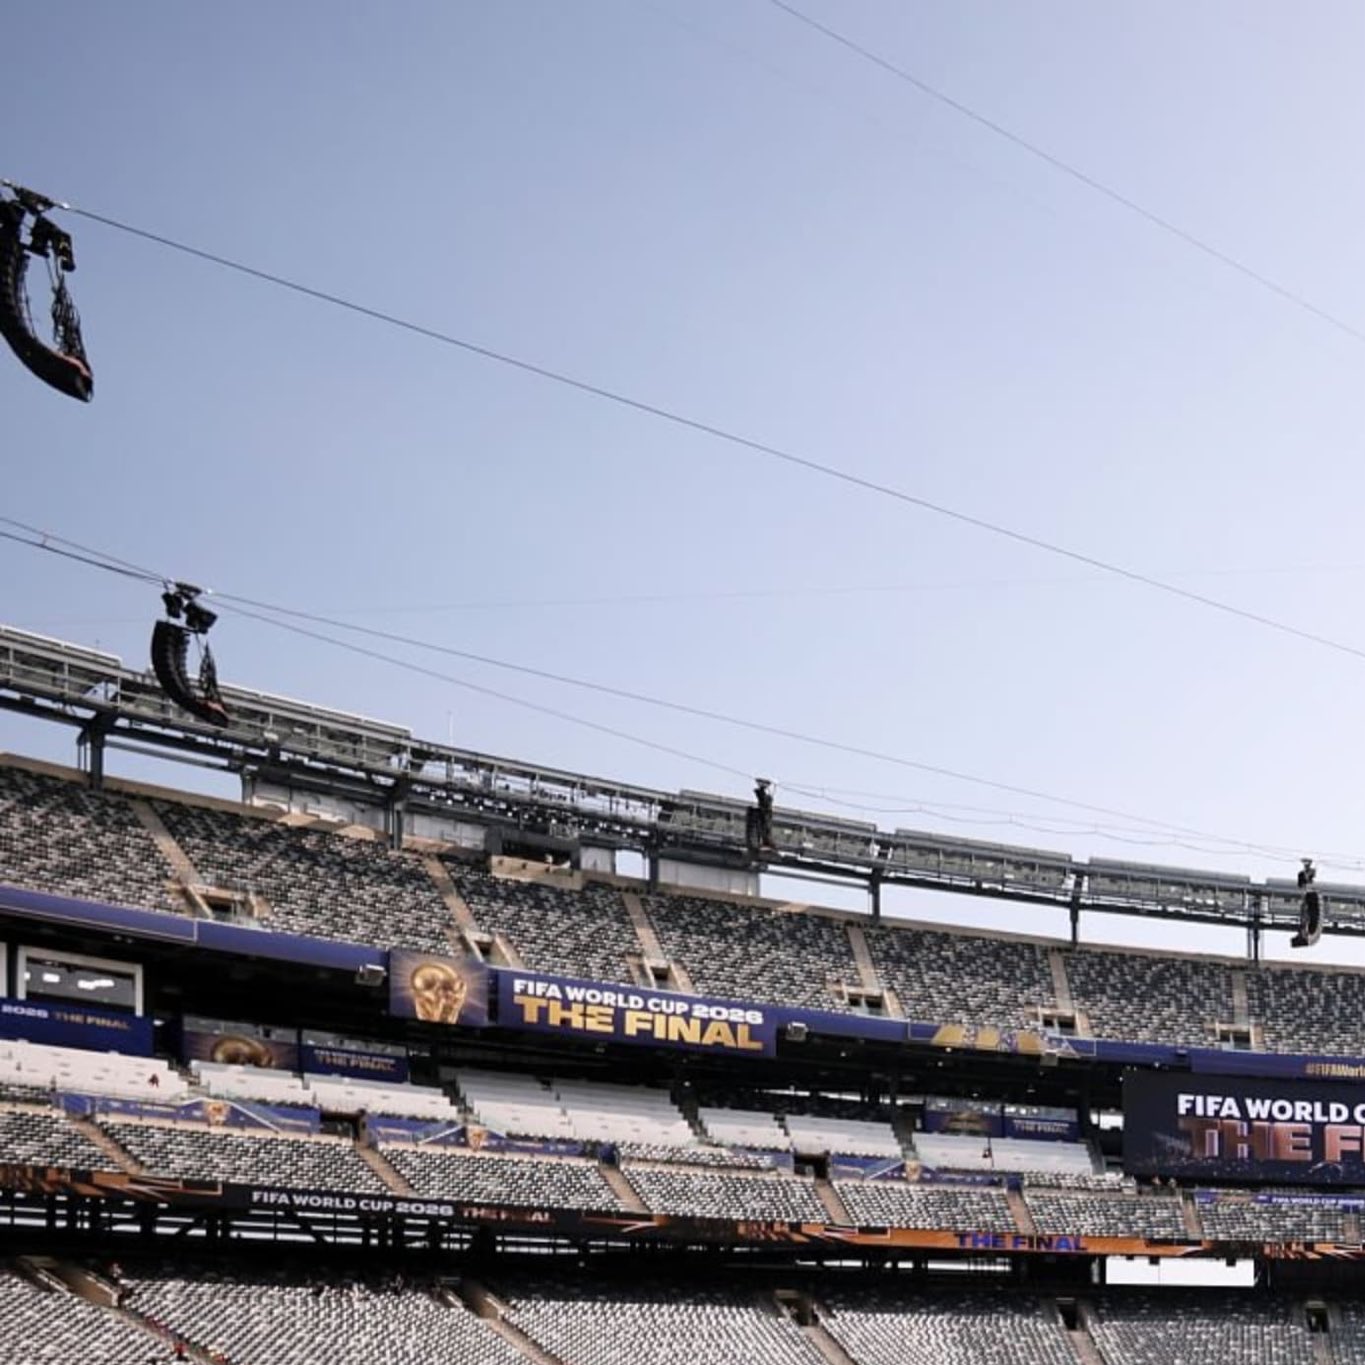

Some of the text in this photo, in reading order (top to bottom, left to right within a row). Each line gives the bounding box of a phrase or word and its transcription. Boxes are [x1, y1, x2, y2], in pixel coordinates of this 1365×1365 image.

[513, 979, 764, 1025] FIFA WORLD CUP 2026
[86, 1015, 131, 1030] FINAL
[513, 994, 764, 1050] THE FINAL
[1178, 1093, 1241, 1118] FIFA
[1245, 1098, 1349, 1123] WORLD
[1178, 1119, 1312, 1162] THE
[252, 1191, 556, 1224] FIFA WORLD CUP 2026 THE FAL
[954, 1232, 1088, 1251] THE FINAL
